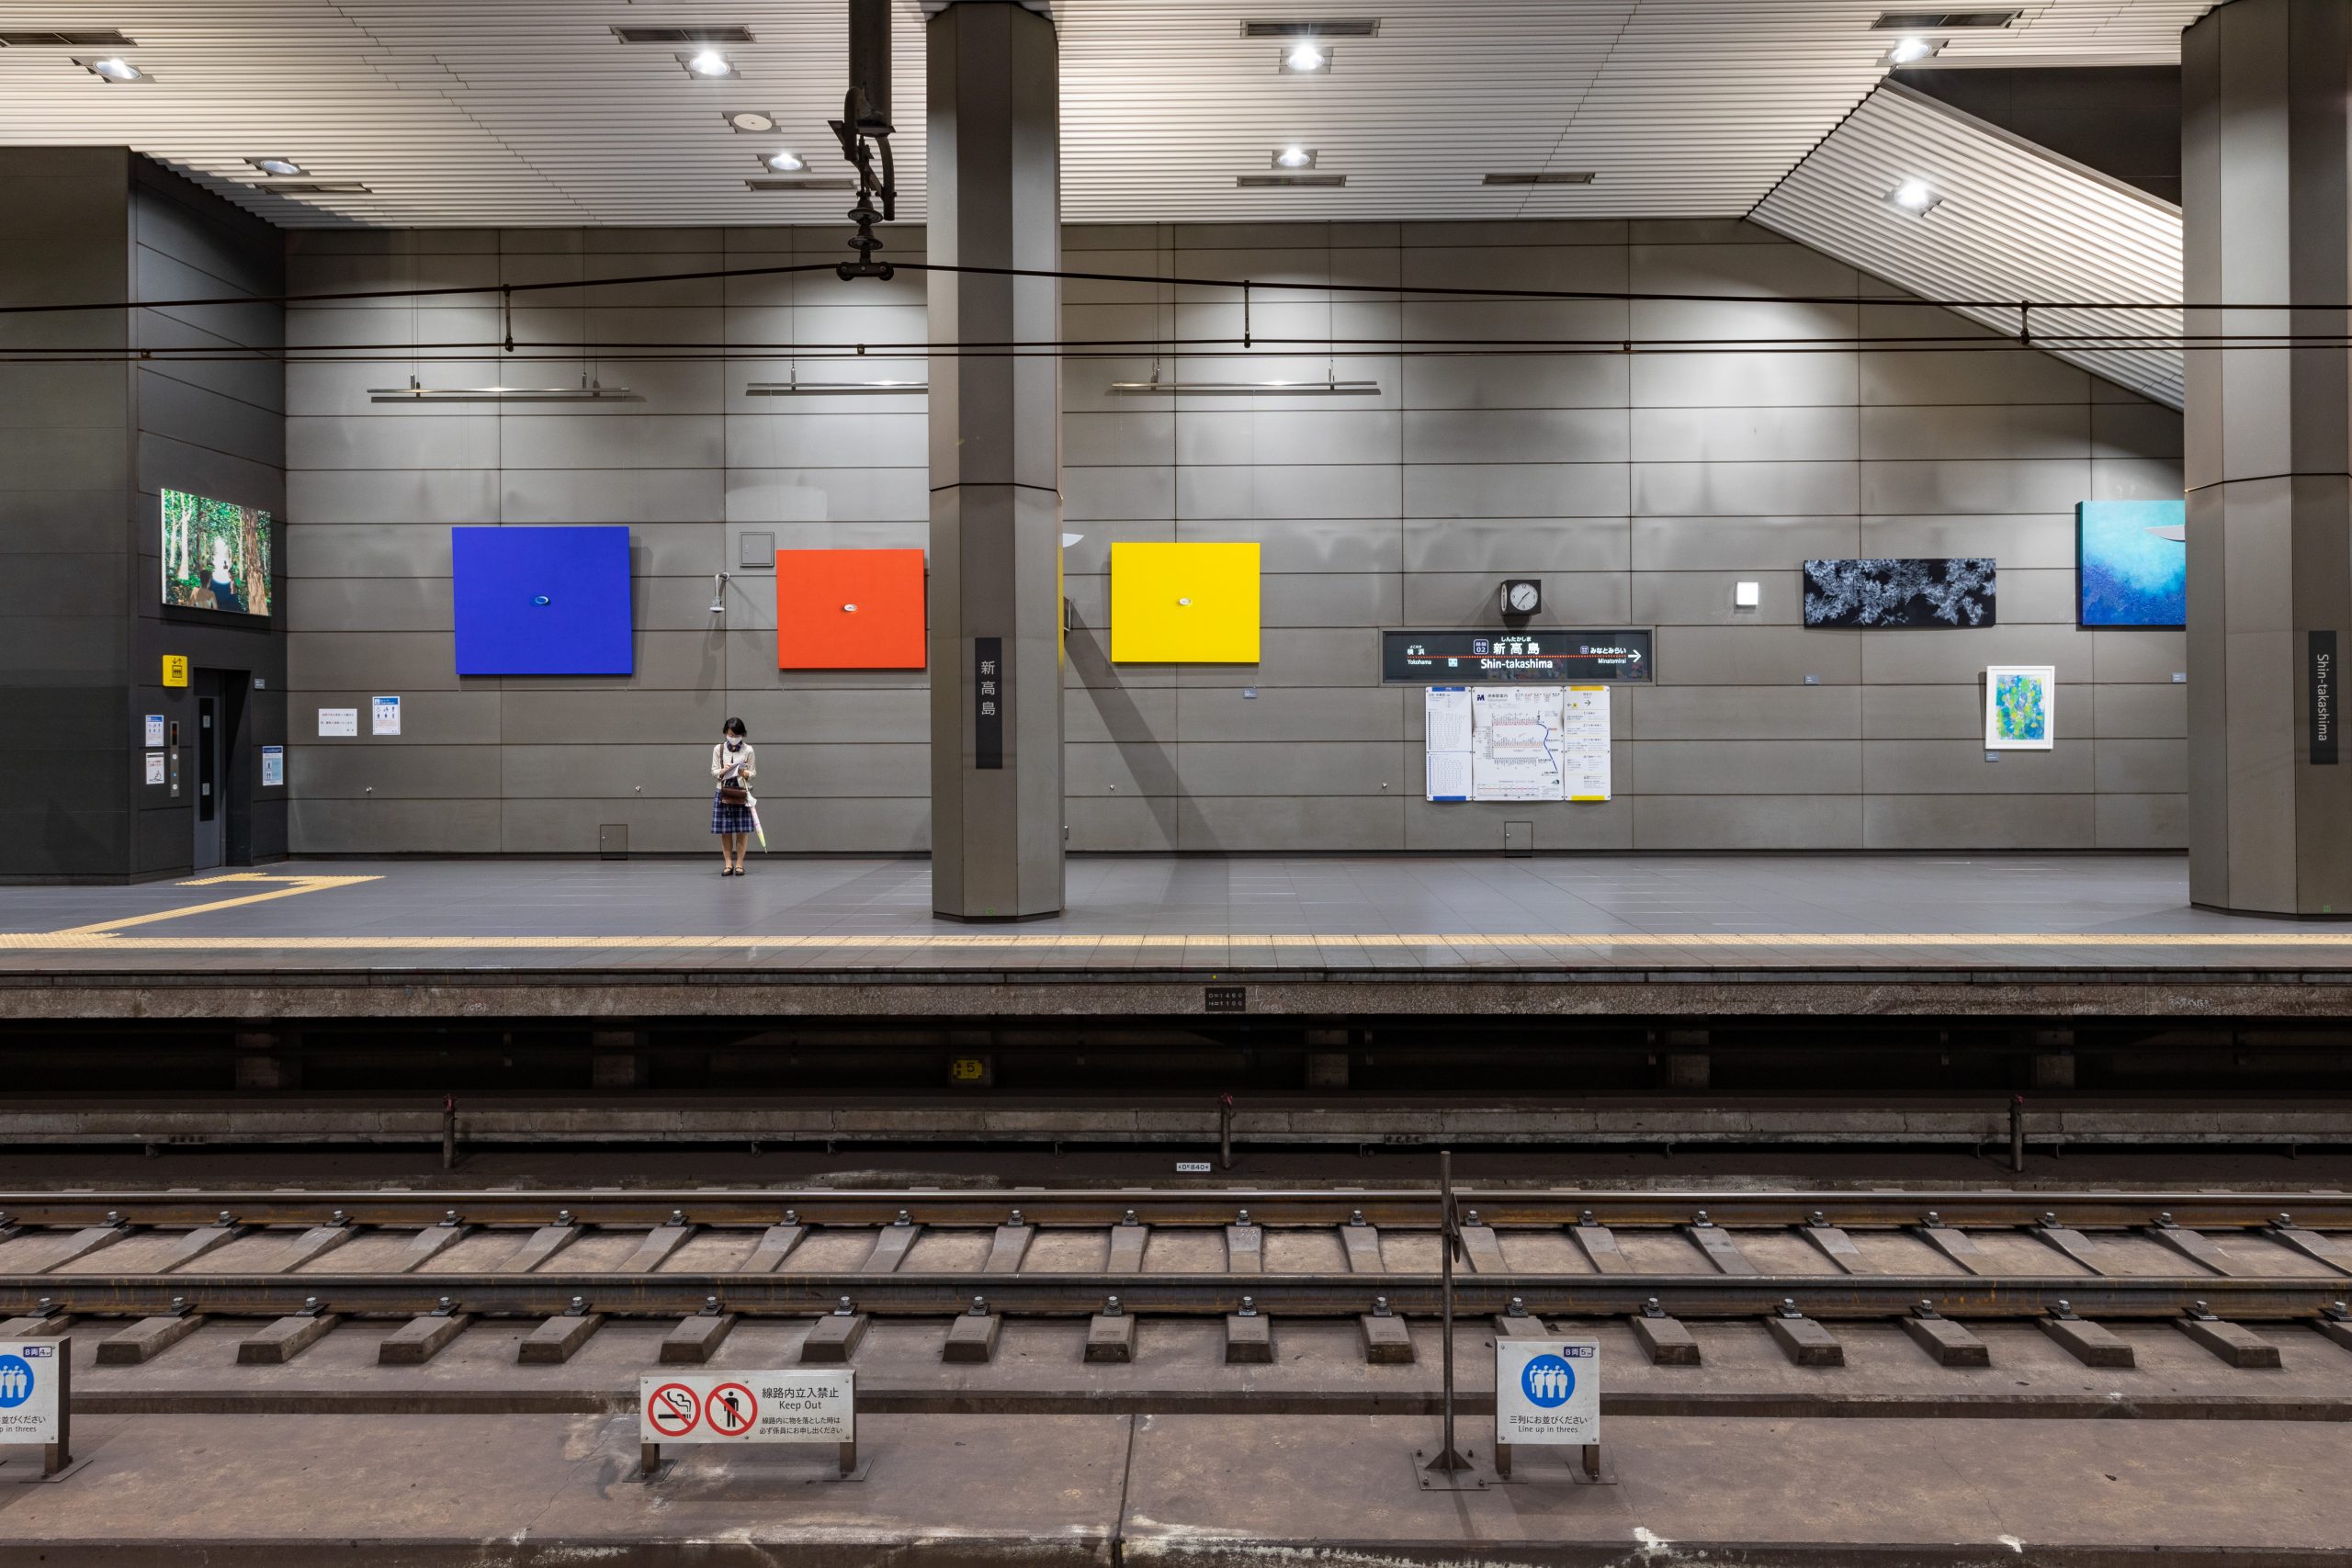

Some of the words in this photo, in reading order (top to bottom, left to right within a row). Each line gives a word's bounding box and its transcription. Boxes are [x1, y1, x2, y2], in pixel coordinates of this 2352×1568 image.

[1493, 643, 1540, 655] 新高島
[1480, 659, 1554, 669] Shin-takashima
[980, 660, 996, 716] 新高島
[2317, 654, 2330, 741] Shin-takashima
[762, 1387, 840, 1399] 線路内立入禁止
[779, 1401, 801, 1411] Keep
[804, 1400, 822, 1410] Out
[0, 1416, 47, 1425] 並びください
[762, 1416, 841, 1425] 線路内に物を落とした時は
[1509, 1416, 1589, 1425] 三列にお並びください
[759, 1427, 843, 1435] 必ず係員にお申し出ください
